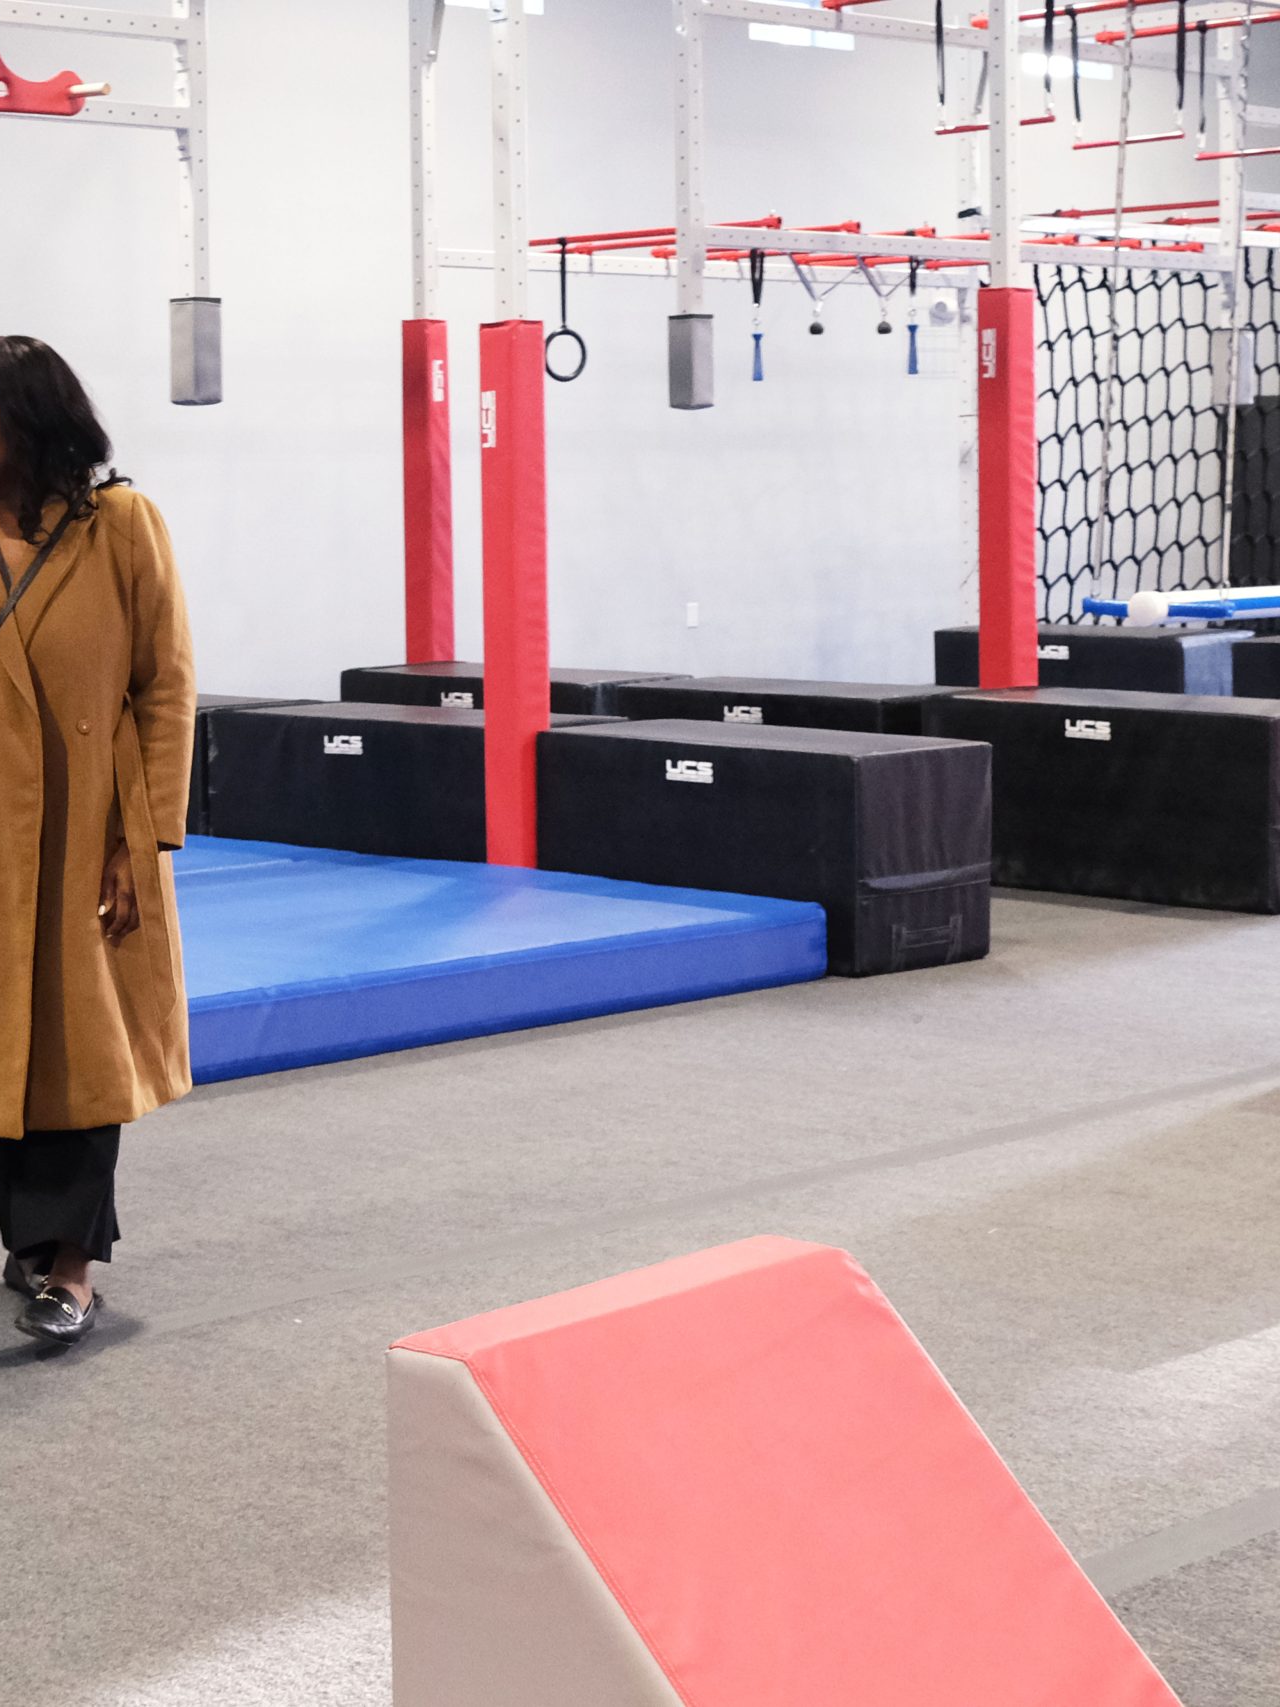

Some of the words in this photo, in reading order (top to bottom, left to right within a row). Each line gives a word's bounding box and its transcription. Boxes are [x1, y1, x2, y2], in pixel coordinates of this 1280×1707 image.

[982, 328, 992, 378] UCS
[481, 390, 491, 448] UCS
[440, 691, 473, 704] UCS
[723, 705, 762, 718] UCS
[1064, 718, 1111, 734] UCS
[323, 735, 363, 748] UCS
[665, 759, 713, 776] UCS
